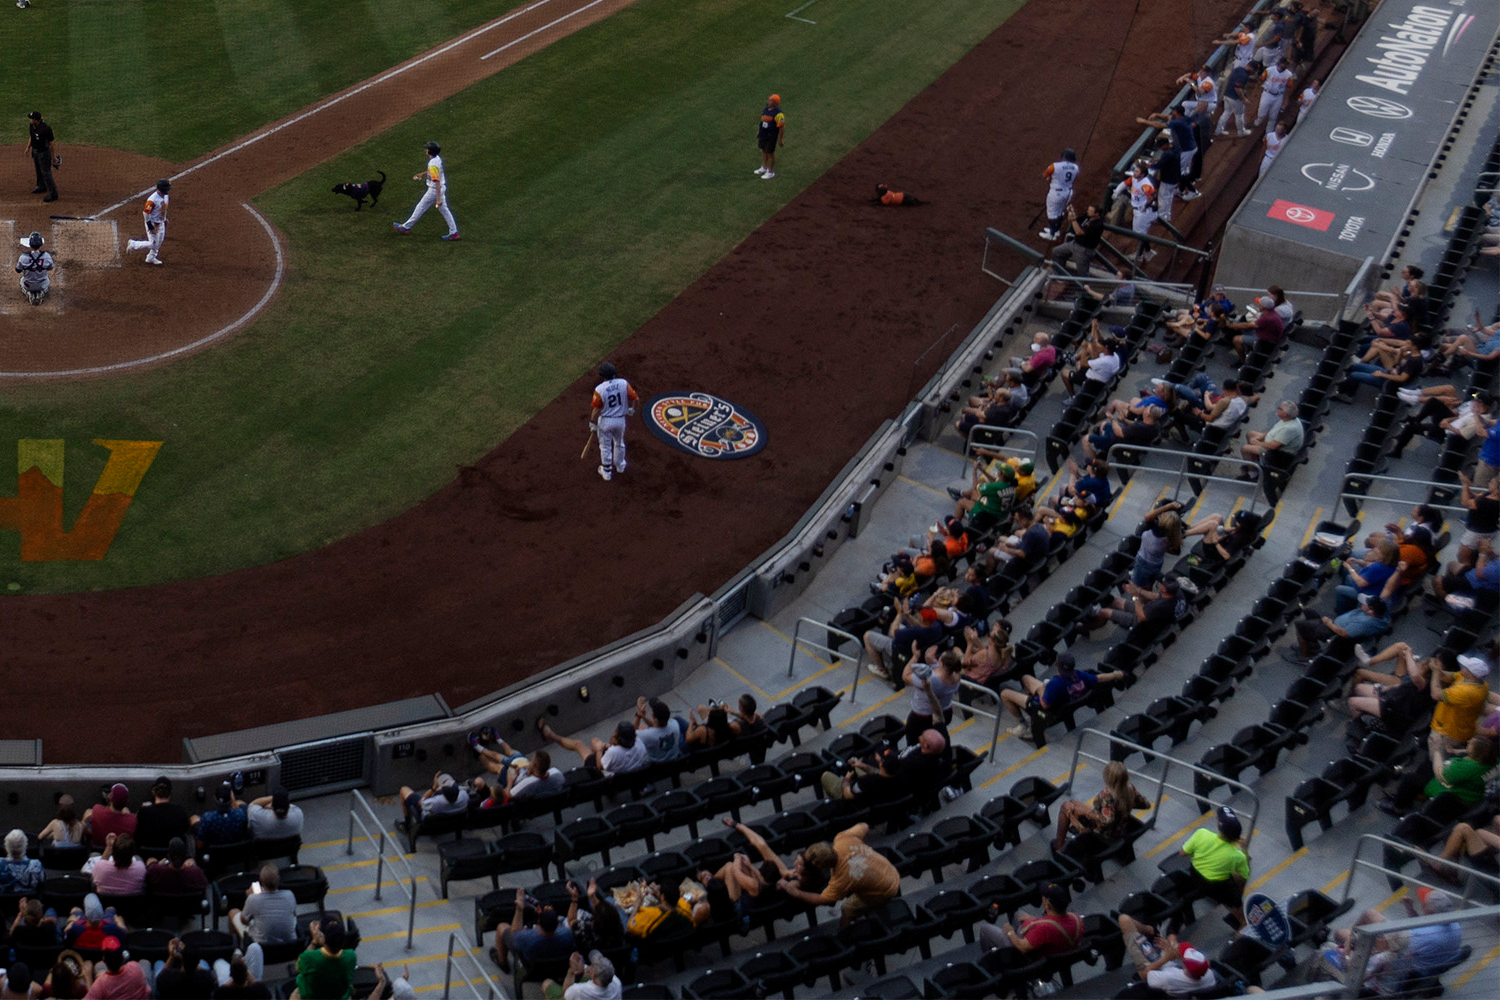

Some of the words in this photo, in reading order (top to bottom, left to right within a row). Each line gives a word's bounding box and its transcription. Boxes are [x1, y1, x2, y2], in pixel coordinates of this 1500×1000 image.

[1354, 5, 1454, 96] AutoNation
[1371, 132, 1397, 159] HONDA
[1064, 171, 1073, 183] 9
[1325, 163, 1350, 191] NISSAN
[1338, 215, 1366, 242] TOYOTA
[607, 392, 622, 408] 21
[680, 402, 730, 447] Steiner's
[398, 743, 411, 752] 110
[249, 770, 261, 779] 111
